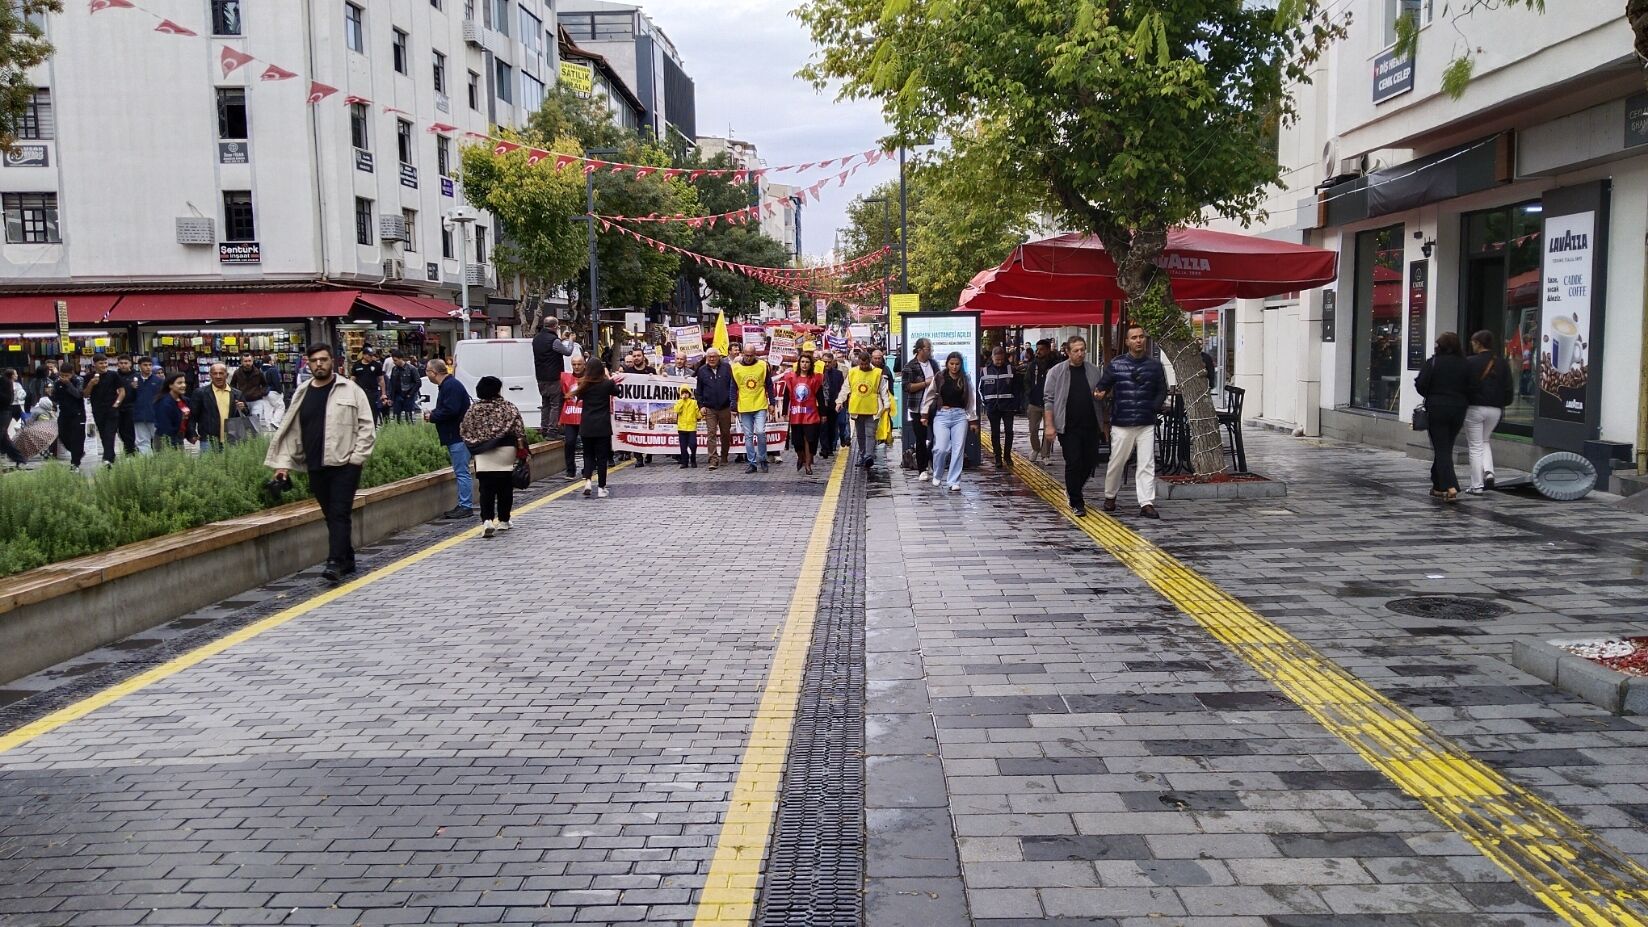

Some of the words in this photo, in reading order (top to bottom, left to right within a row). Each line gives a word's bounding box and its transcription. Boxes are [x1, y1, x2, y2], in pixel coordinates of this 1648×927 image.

[562, 68, 590, 81] SATILIK
[1379, 75, 1392, 90] CENK
[1393, 67, 1410, 84] CELEP
[1549, 230, 1588, 253] LAVAZZA
[1564, 274, 1583, 286] CADDE
[1568, 286, 1587, 296] COFFE
[627, 435, 666, 445] OKULUMU
